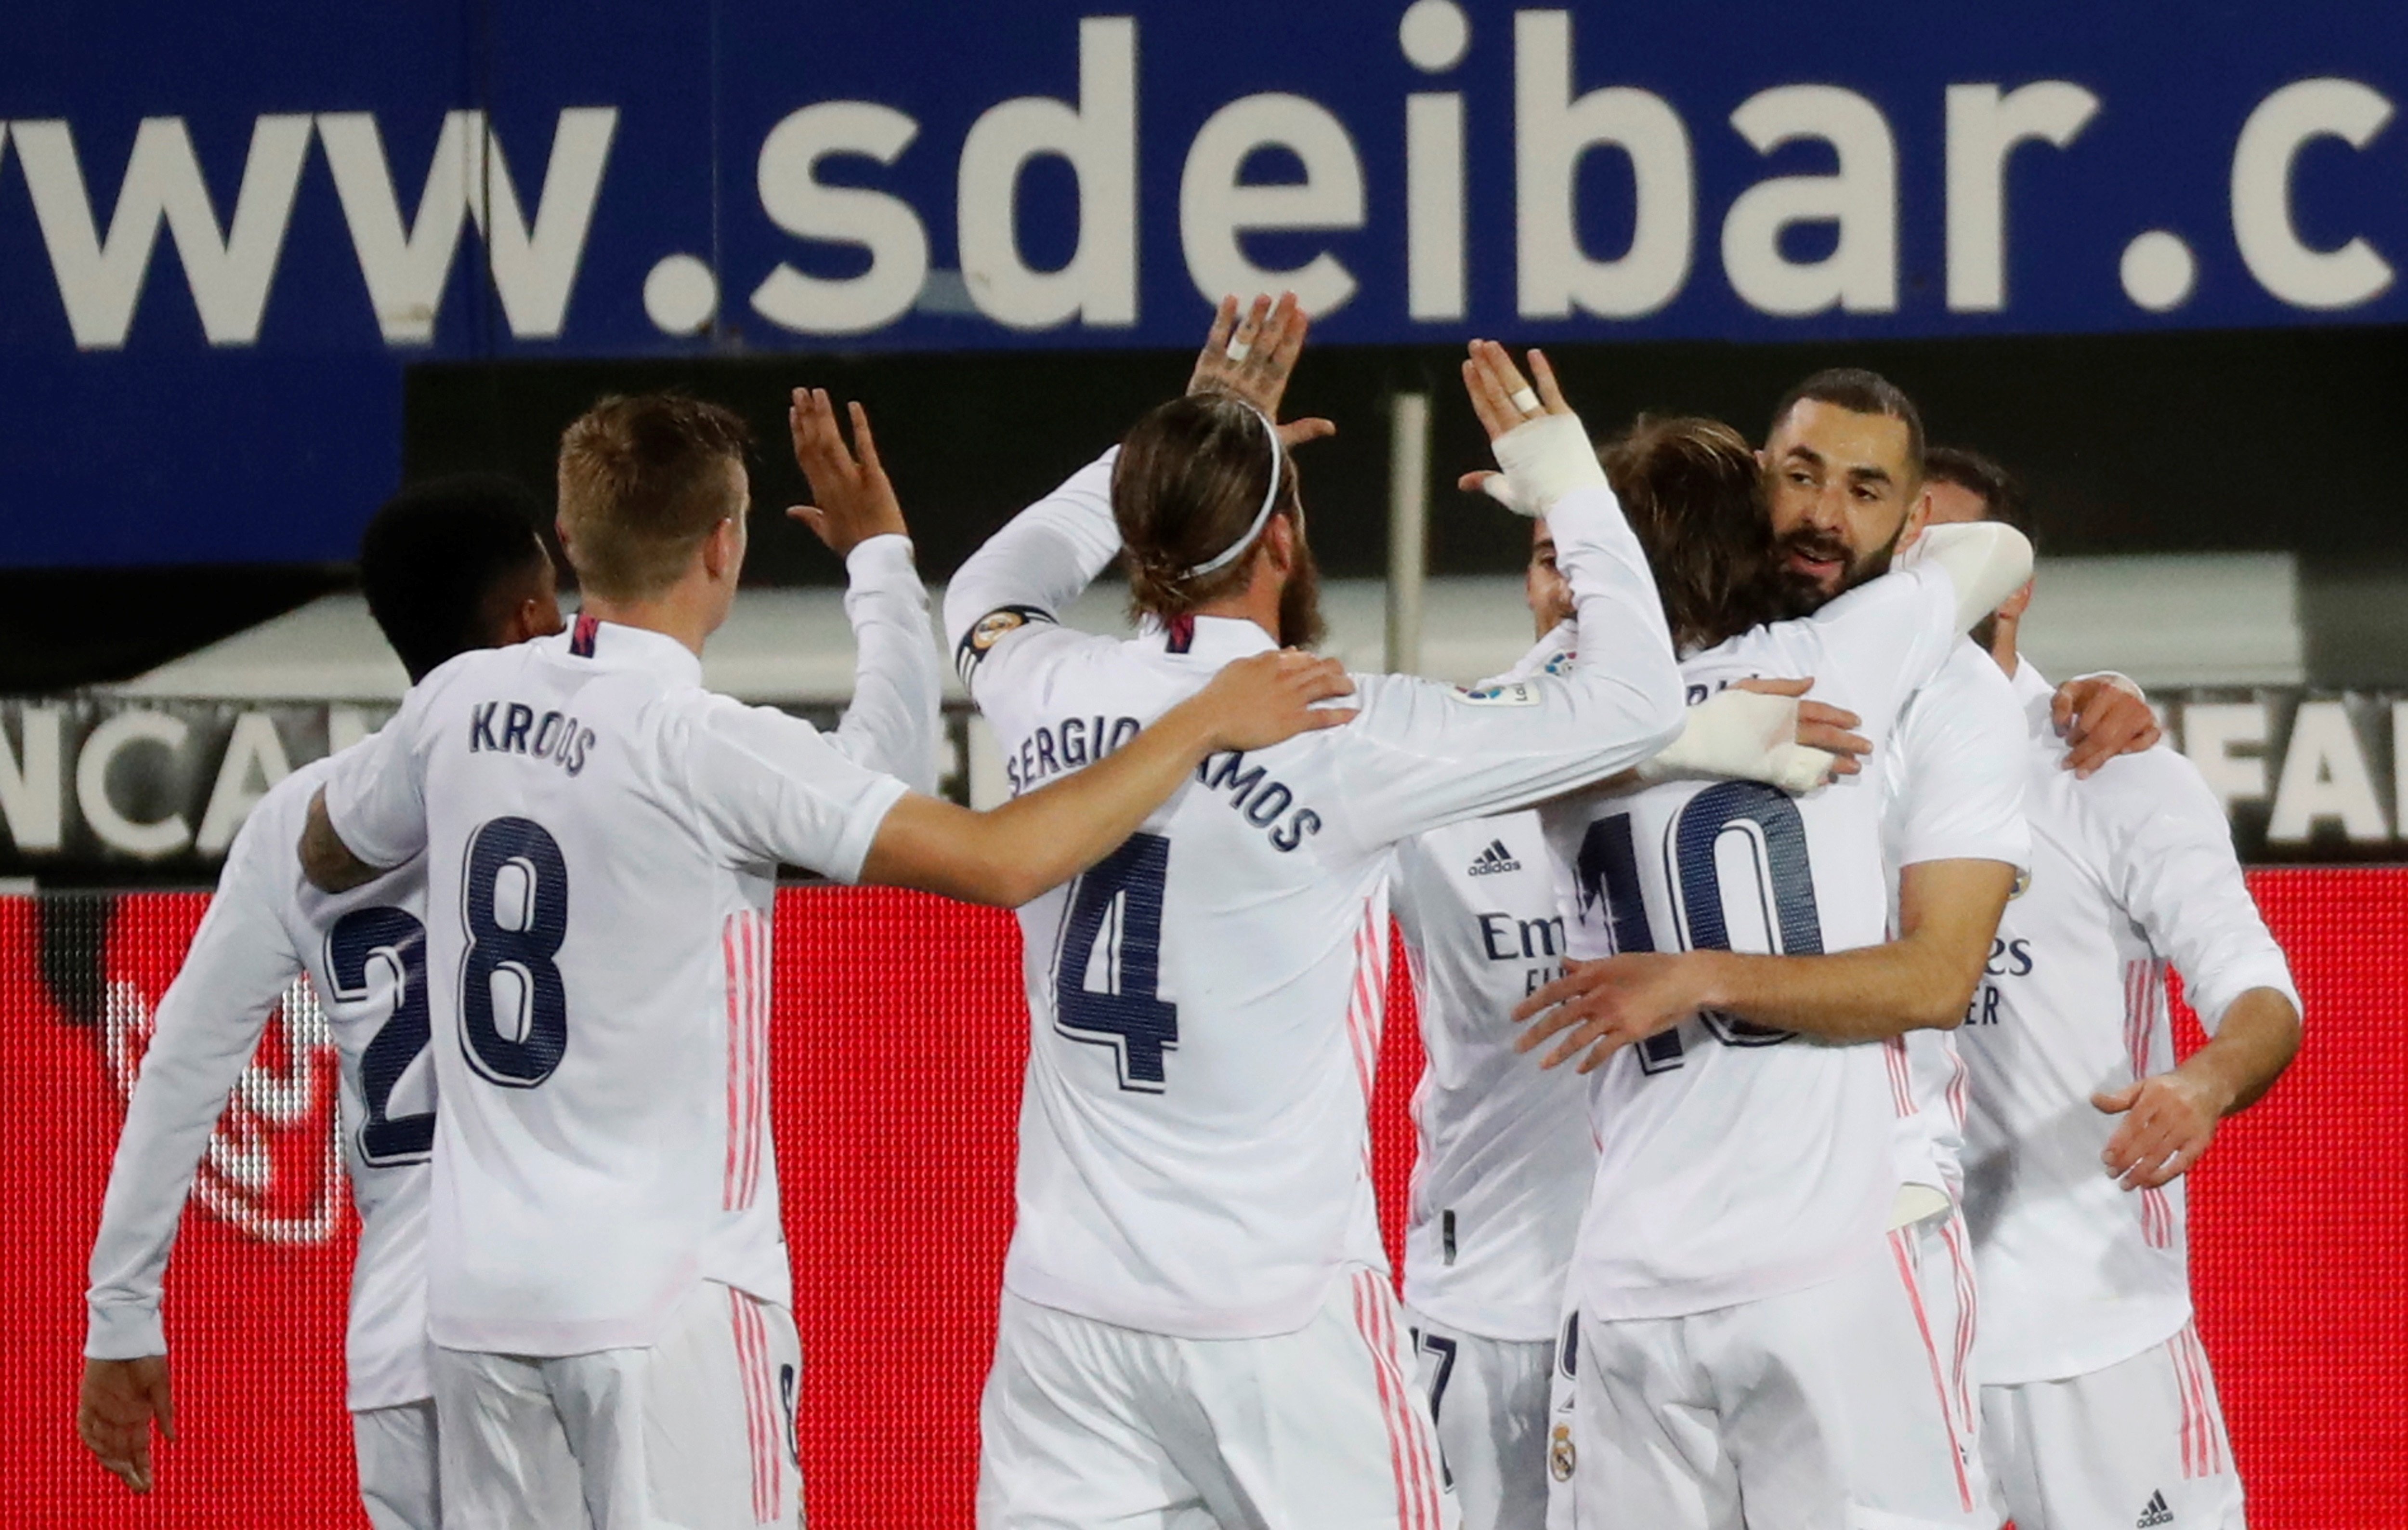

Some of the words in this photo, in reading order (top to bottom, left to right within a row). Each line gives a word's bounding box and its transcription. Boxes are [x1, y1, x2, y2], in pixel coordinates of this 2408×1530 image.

[0, 1, 2396, 351] ww.sdeibar.c
[0, 702, 368, 860] NCA
[470, 700, 596, 778] KROOS
[1468, 860, 1522, 876] adidas
[458, 816, 568, 1089] 8
[1049, 831, 1178, 1094] 4
[1571, 780, 1826, 1076] 10
